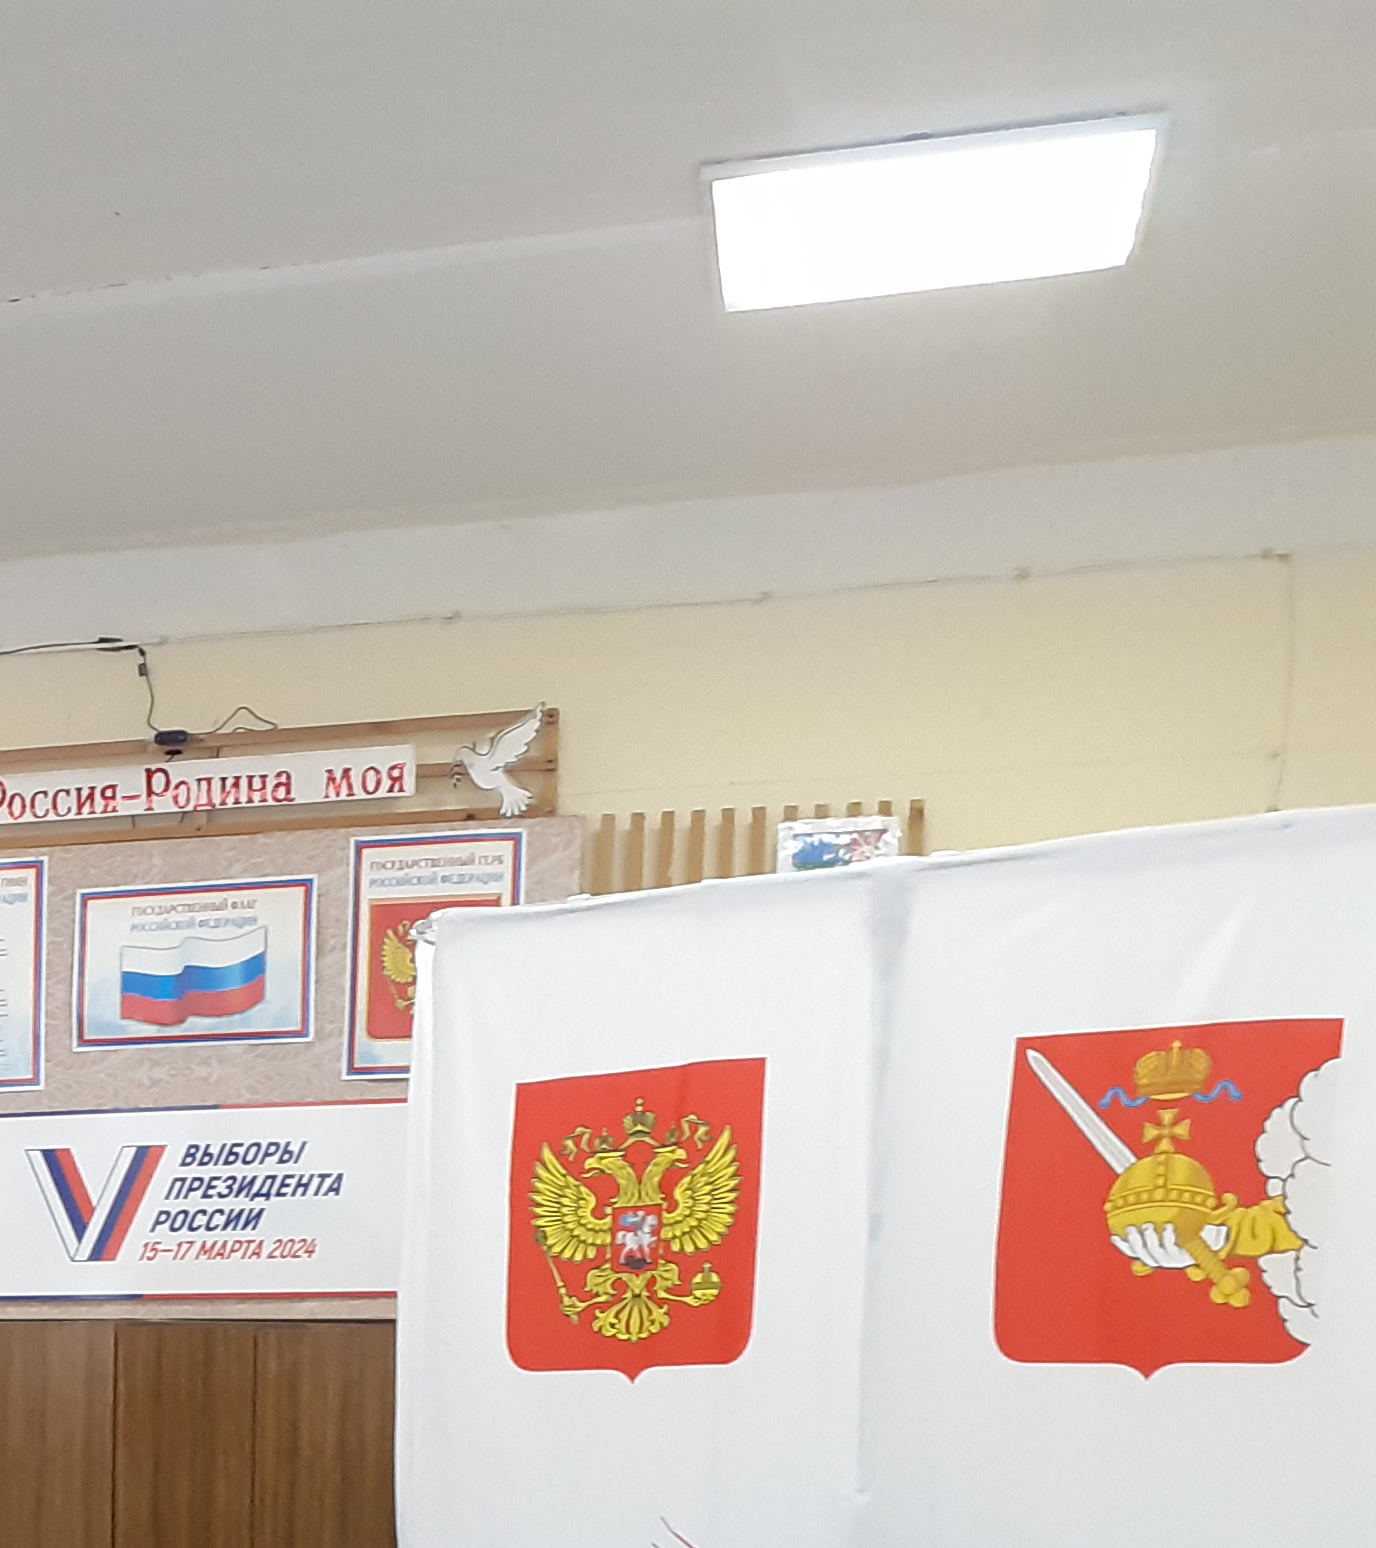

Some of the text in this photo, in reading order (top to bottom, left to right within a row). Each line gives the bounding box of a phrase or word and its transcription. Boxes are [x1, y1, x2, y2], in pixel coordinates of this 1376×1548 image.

[323, 762, 408, 800] моя
[178, 1140, 308, 1168] ВЫБОРЫ
[163, 1172, 345, 1202] ПРЕЗИДЕНТА
[148, 1207, 266, 1233] РОССИИ
[194, 1238, 266, 1261] МАРТА
[266, 1237, 318, 1260] 2024
